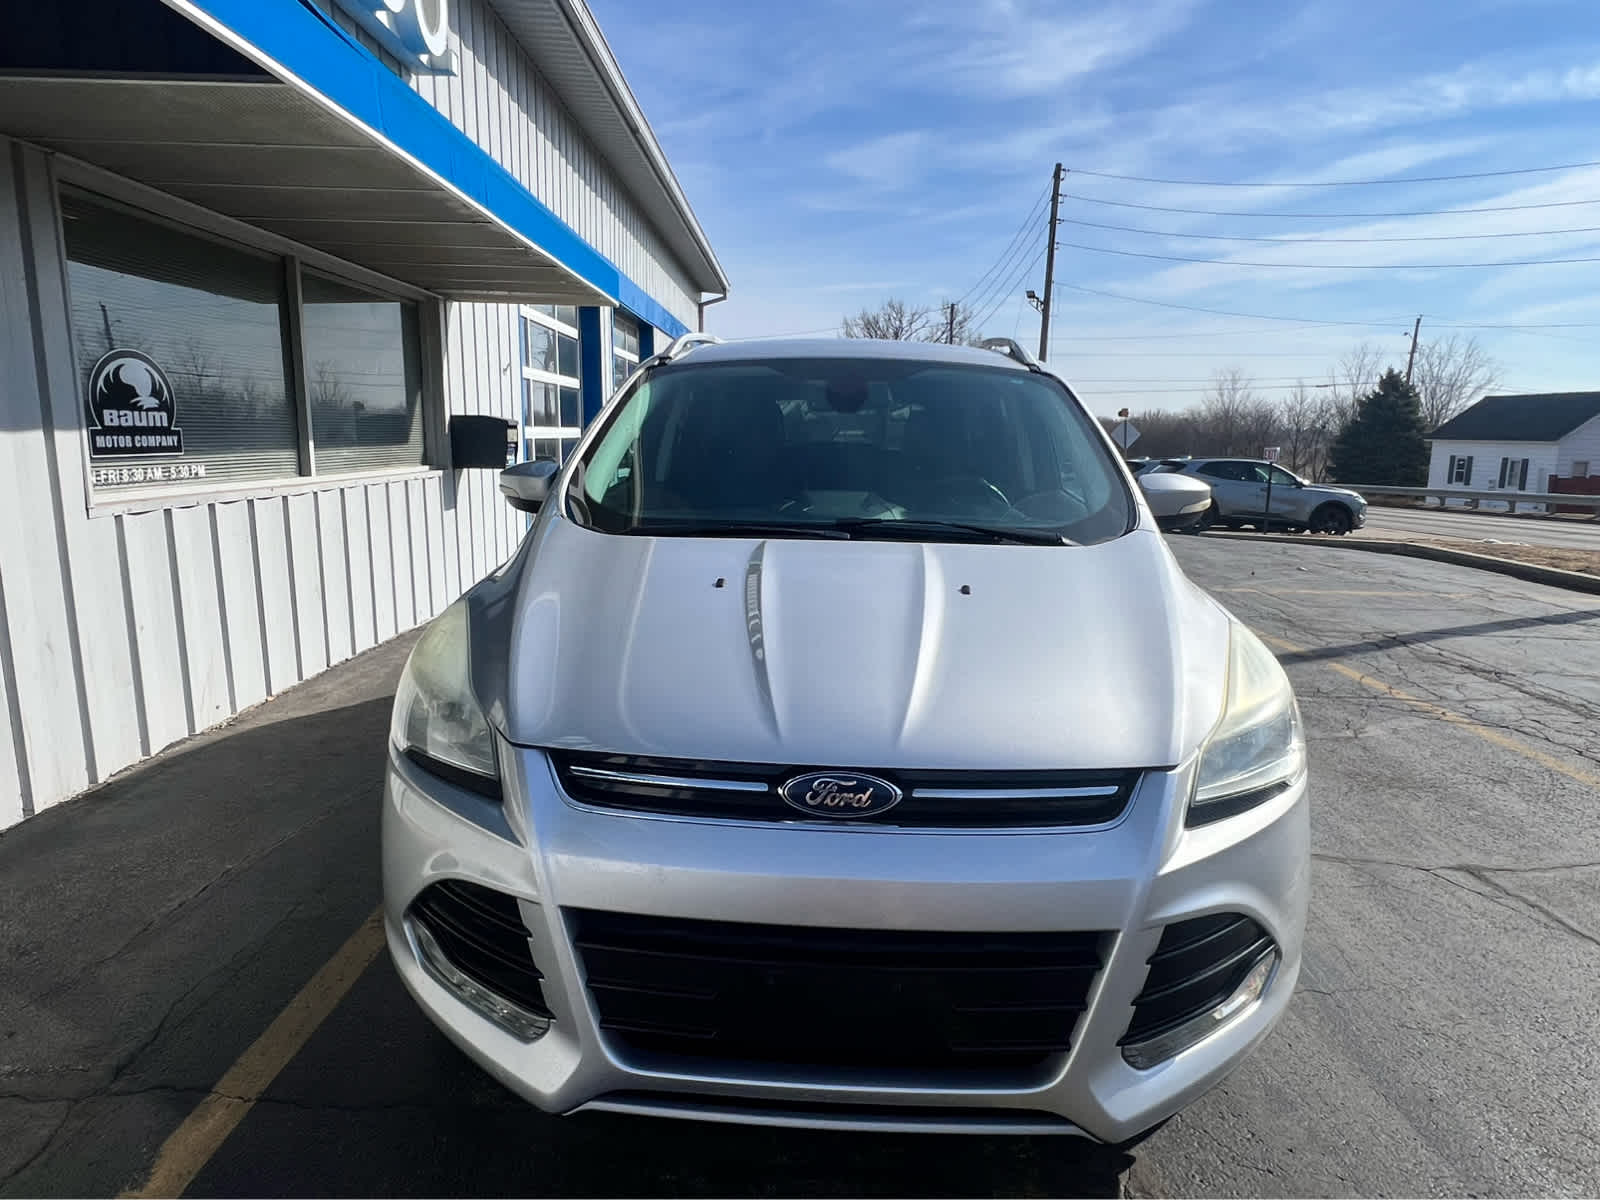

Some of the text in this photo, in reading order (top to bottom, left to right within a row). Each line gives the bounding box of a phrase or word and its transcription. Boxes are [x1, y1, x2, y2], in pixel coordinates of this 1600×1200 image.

[103, 409, 168, 427] Baum
[96, 435, 178, 448] MOTOR COMPANY
[122, 468, 144, 481] 8:30
[147, 466, 162, 480] AM
[170, 466, 189, 478] 5:30
[191, 465, 206, 478] PM
[805, 778, 874, 807] Ford
